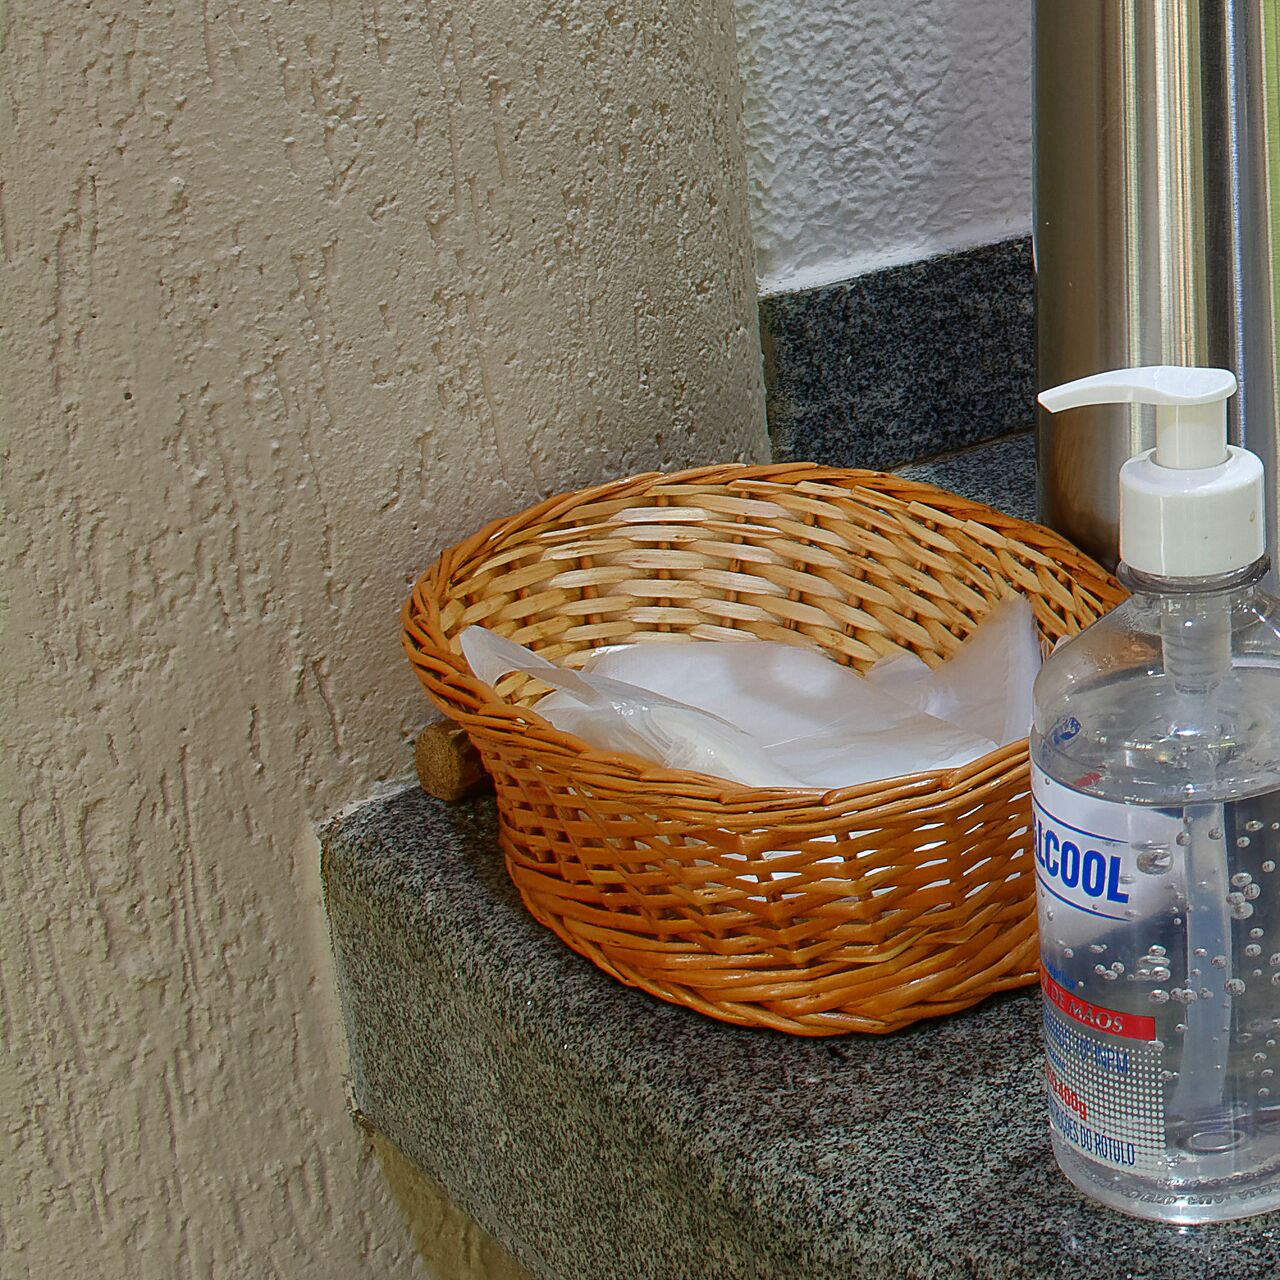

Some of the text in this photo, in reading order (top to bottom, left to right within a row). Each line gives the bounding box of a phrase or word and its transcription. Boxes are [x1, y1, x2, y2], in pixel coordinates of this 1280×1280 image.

[1069, 999, 1123, 1032] MÃOS
[1081, 1125, 1135, 1166] DO RÓTULO
